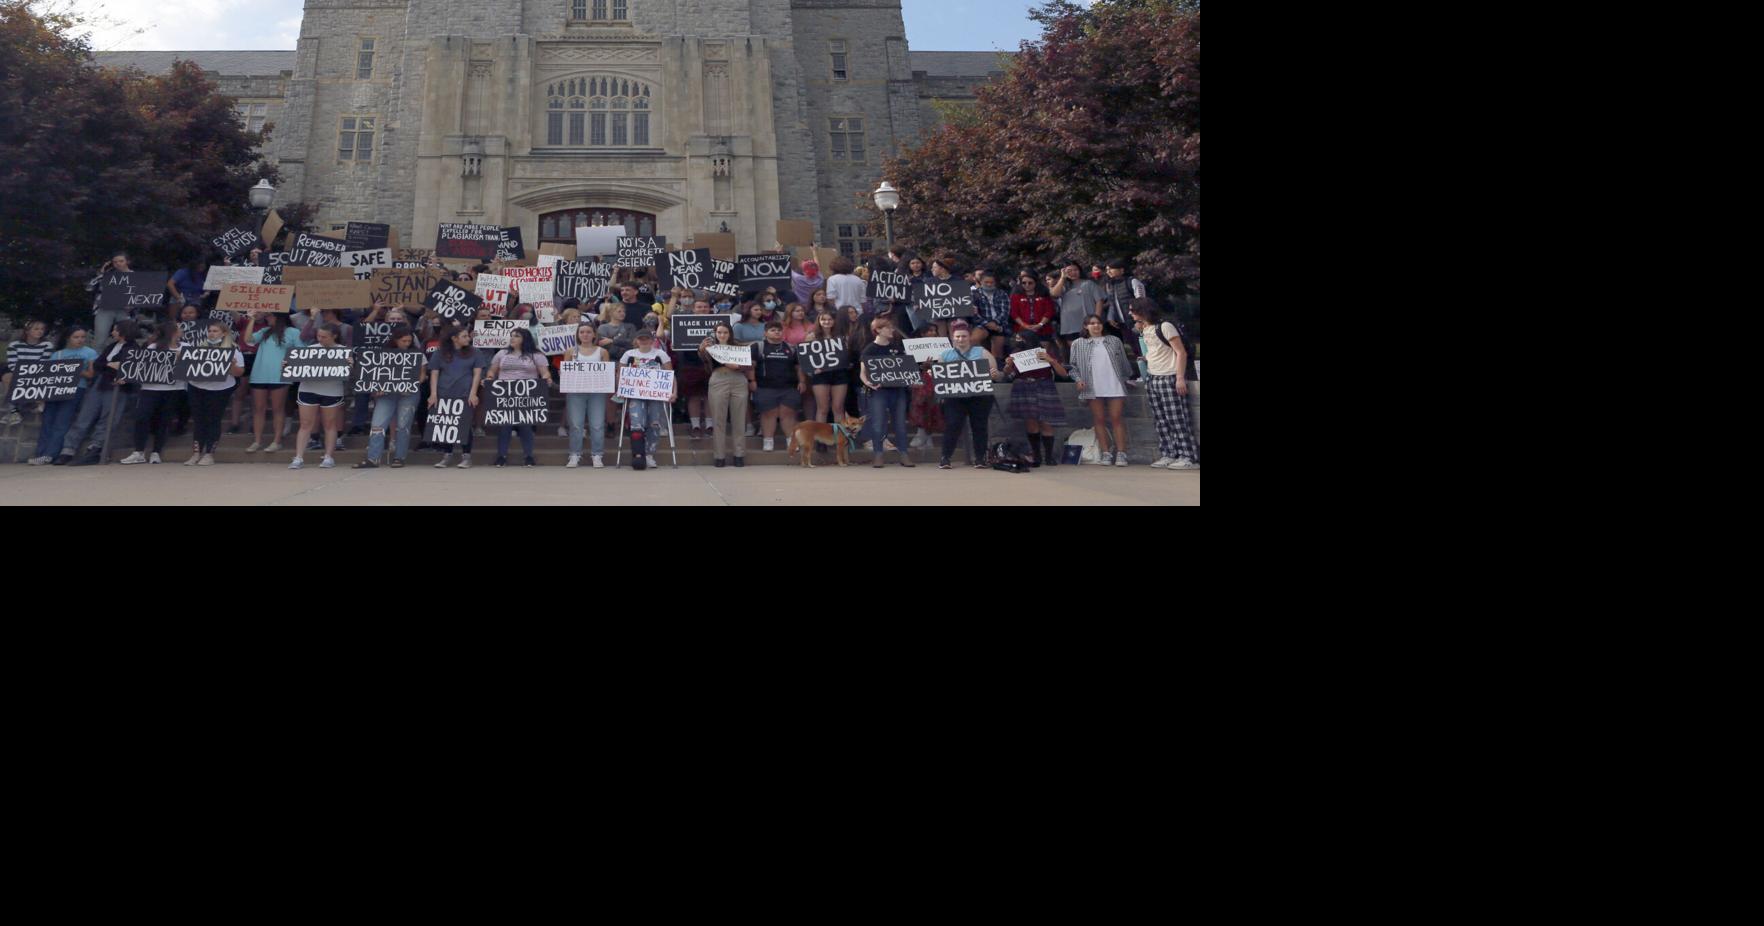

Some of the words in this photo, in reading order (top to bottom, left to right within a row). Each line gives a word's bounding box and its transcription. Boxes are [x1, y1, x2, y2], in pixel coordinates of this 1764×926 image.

[212, 227, 245, 247] EXPEL
[297, 233, 346, 252] REMEMBER
[441, 232, 484, 241] PLAGIARISM
[500, 230, 510, 241] E
[634, 238, 646, 248] IS
[647, 237, 657, 249] A
[289, 247, 308, 263] UT
[350, 250, 387, 267] SAFE
[618, 248, 664, 259] COMPLETE
[668, 249, 697, 266] NO
[560, 260, 611, 277] REMEMBER
[669, 262, 703, 275] MEANS
[713, 269, 724, 280] he
[743, 261, 790, 277] NOW
[109, 275, 129, 285] AM
[378, 275, 437, 292] STAND
[556, 275, 575, 297] UT
[672, 273, 699, 289] NO
[123, 285, 136, 295] I
[229, 285, 289, 295] SILENCE
[444, 285, 466, 301] NO
[485, 288, 507, 302] UT
[875, 283, 906, 300] NOW
[924, 282, 953, 297] NO
[127, 293, 164, 305] NEXT?
[248, 293, 260, 301] IS
[370, 291, 413, 305] WITH
[431, 291, 476, 317] means
[919, 295, 973, 310] MEANS
[224, 301, 281, 311] VIOLENCE
[432, 301, 456, 318] NO
[931, 307, 956, 319] NO!
[483, 320, 515, 329] END
[364, 335, 381, 344] IS
[798, 337, 844, 355] JOIN
[181, 349, 232, 362] ACTION
[289, 348, 352, 360] SUPPORT
[359, 350, 422, 367] SUPPORT
[808, 351, 840, 369] US
[18, 364, 45, 376] 50%
[50, 363, 65, 373] OF
[186, 361, 232, 378] NOW
[867, 357, 904, 371] STOP
[931, 360, 990, 379] REAL
[282, 365, 351, 378] SURVIVORS
[359, 366, 413, 381] MALE
[655, 369, 673, 381] THE
[17, 375, 74, 387] STUDENTS
[354, 380, 420, 393] SURVIVORS
[490, 379, 537, 397] STOP
[934, 379, 994, 395] CHANGE
[11, 385, 56, 401] DONT
[620, 386, 635, 396] THE
[437, 398, 464, 415] NO
[496, 396, 547, 408] PROTECTING
[426, 414, 461, 426] MEANS
[484, 408, 549, 425] ASSAILANTS
[431, 424, 461, 444] NO.
